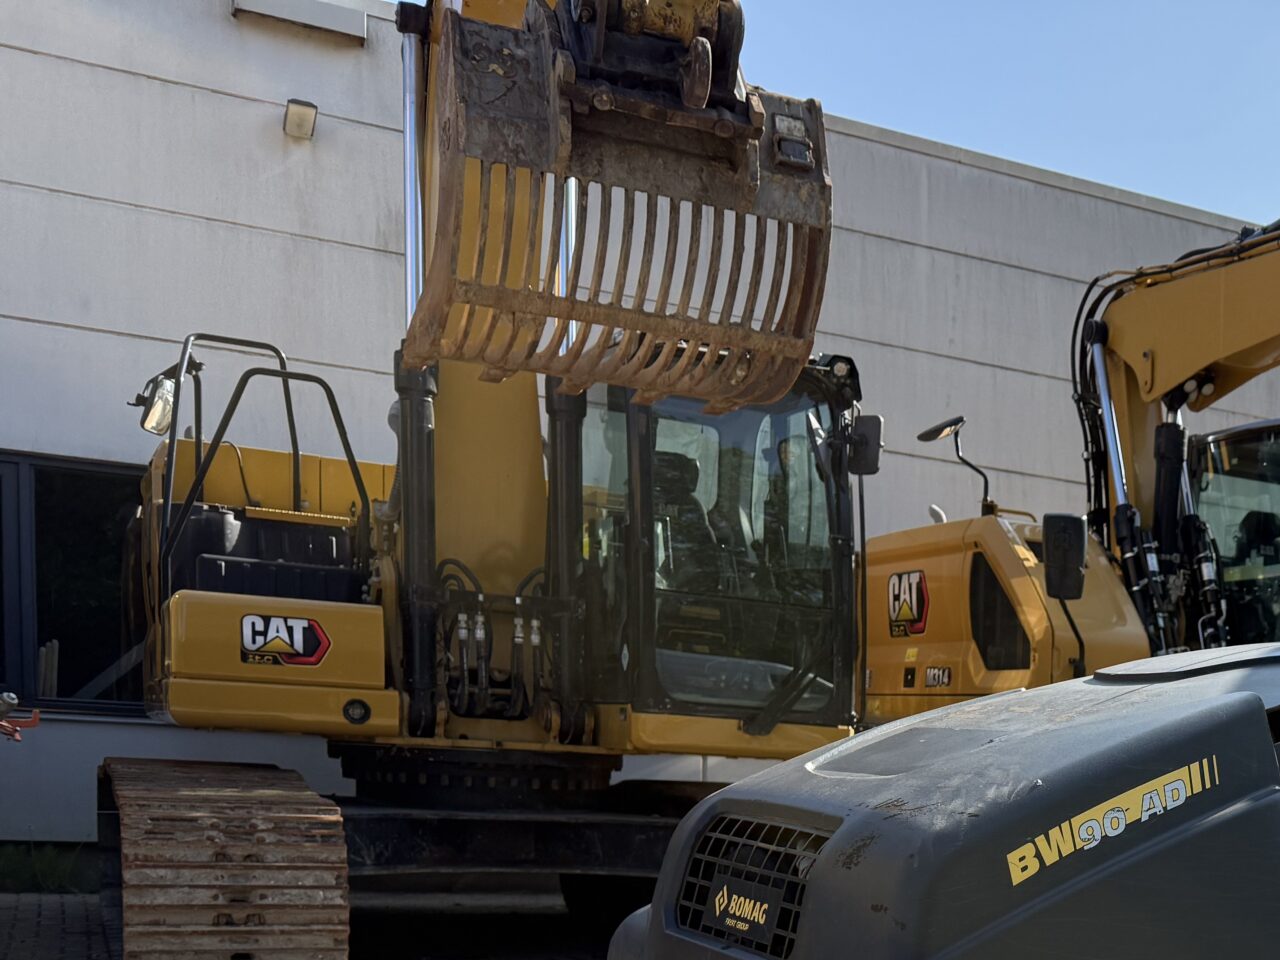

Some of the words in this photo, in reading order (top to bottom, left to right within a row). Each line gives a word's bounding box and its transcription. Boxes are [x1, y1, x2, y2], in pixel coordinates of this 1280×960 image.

[888, 571, 920, 621] CAT
[242, 614, 309, 654] CAT
[925, 667, 951, 687] M314
[1141, 779, 1187, 823] AD
[728, 894, 769, 925] BOMAG
